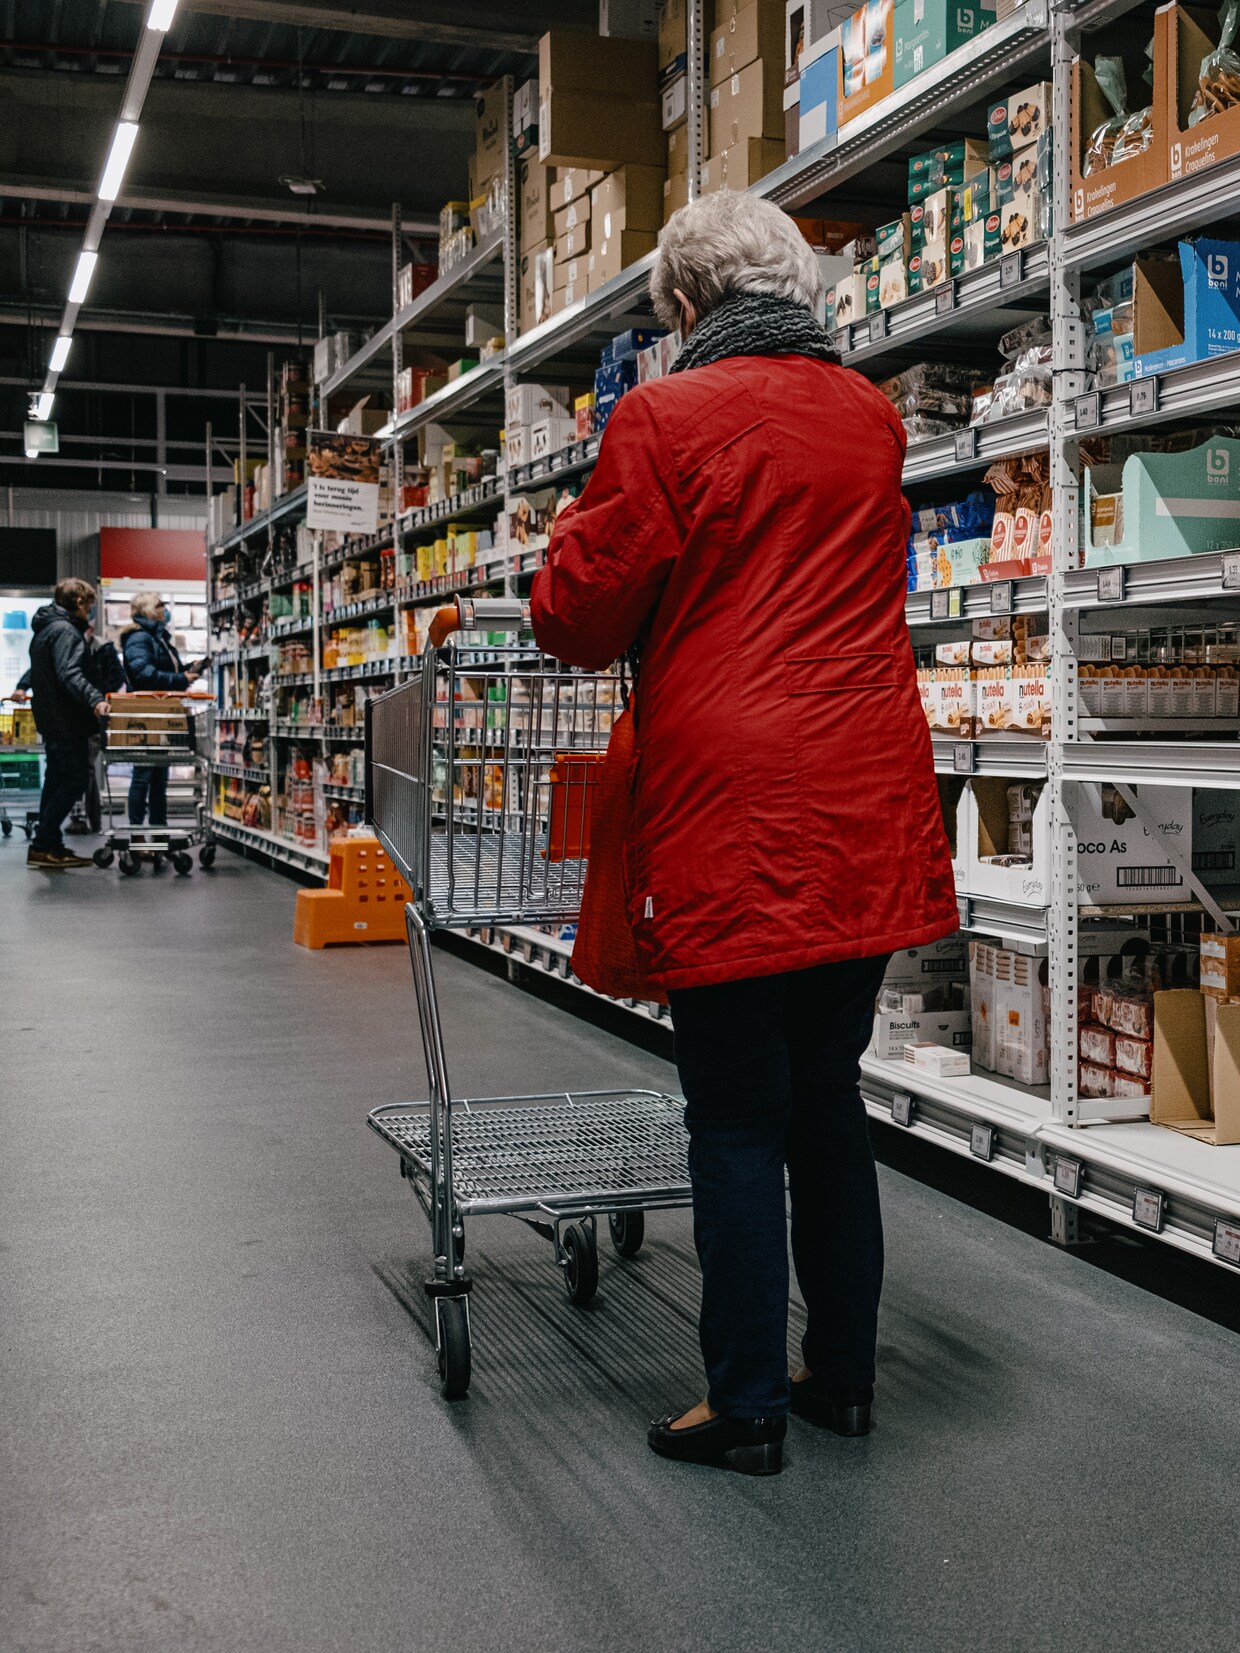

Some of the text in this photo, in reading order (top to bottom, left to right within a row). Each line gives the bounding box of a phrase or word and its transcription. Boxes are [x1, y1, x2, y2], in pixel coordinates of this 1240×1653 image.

[1184, 133, 1220, 158] Krakelingen
[1185, 151, 1216, 173] Craquelins
[1086, 182, 1117, 202] Krakelingen
[1208, 278, 1228, 288] boni
[1208, 328, 1216, 339] 14
[1223, 330, 1236, 340] 200
[1207, 474, 1228, 484] boni
[328, 485, 345, 494] terug
[941, 683, 963, 698] nutella
[982, 683, 1004, 698] nutella
[1018, 680, 1044, 696] nutella
[1200, 810, 1235, 824] Everyday
[1076, 840, 1127, 854] oco As
[889, 1020, 920, 1030] Biscuits
